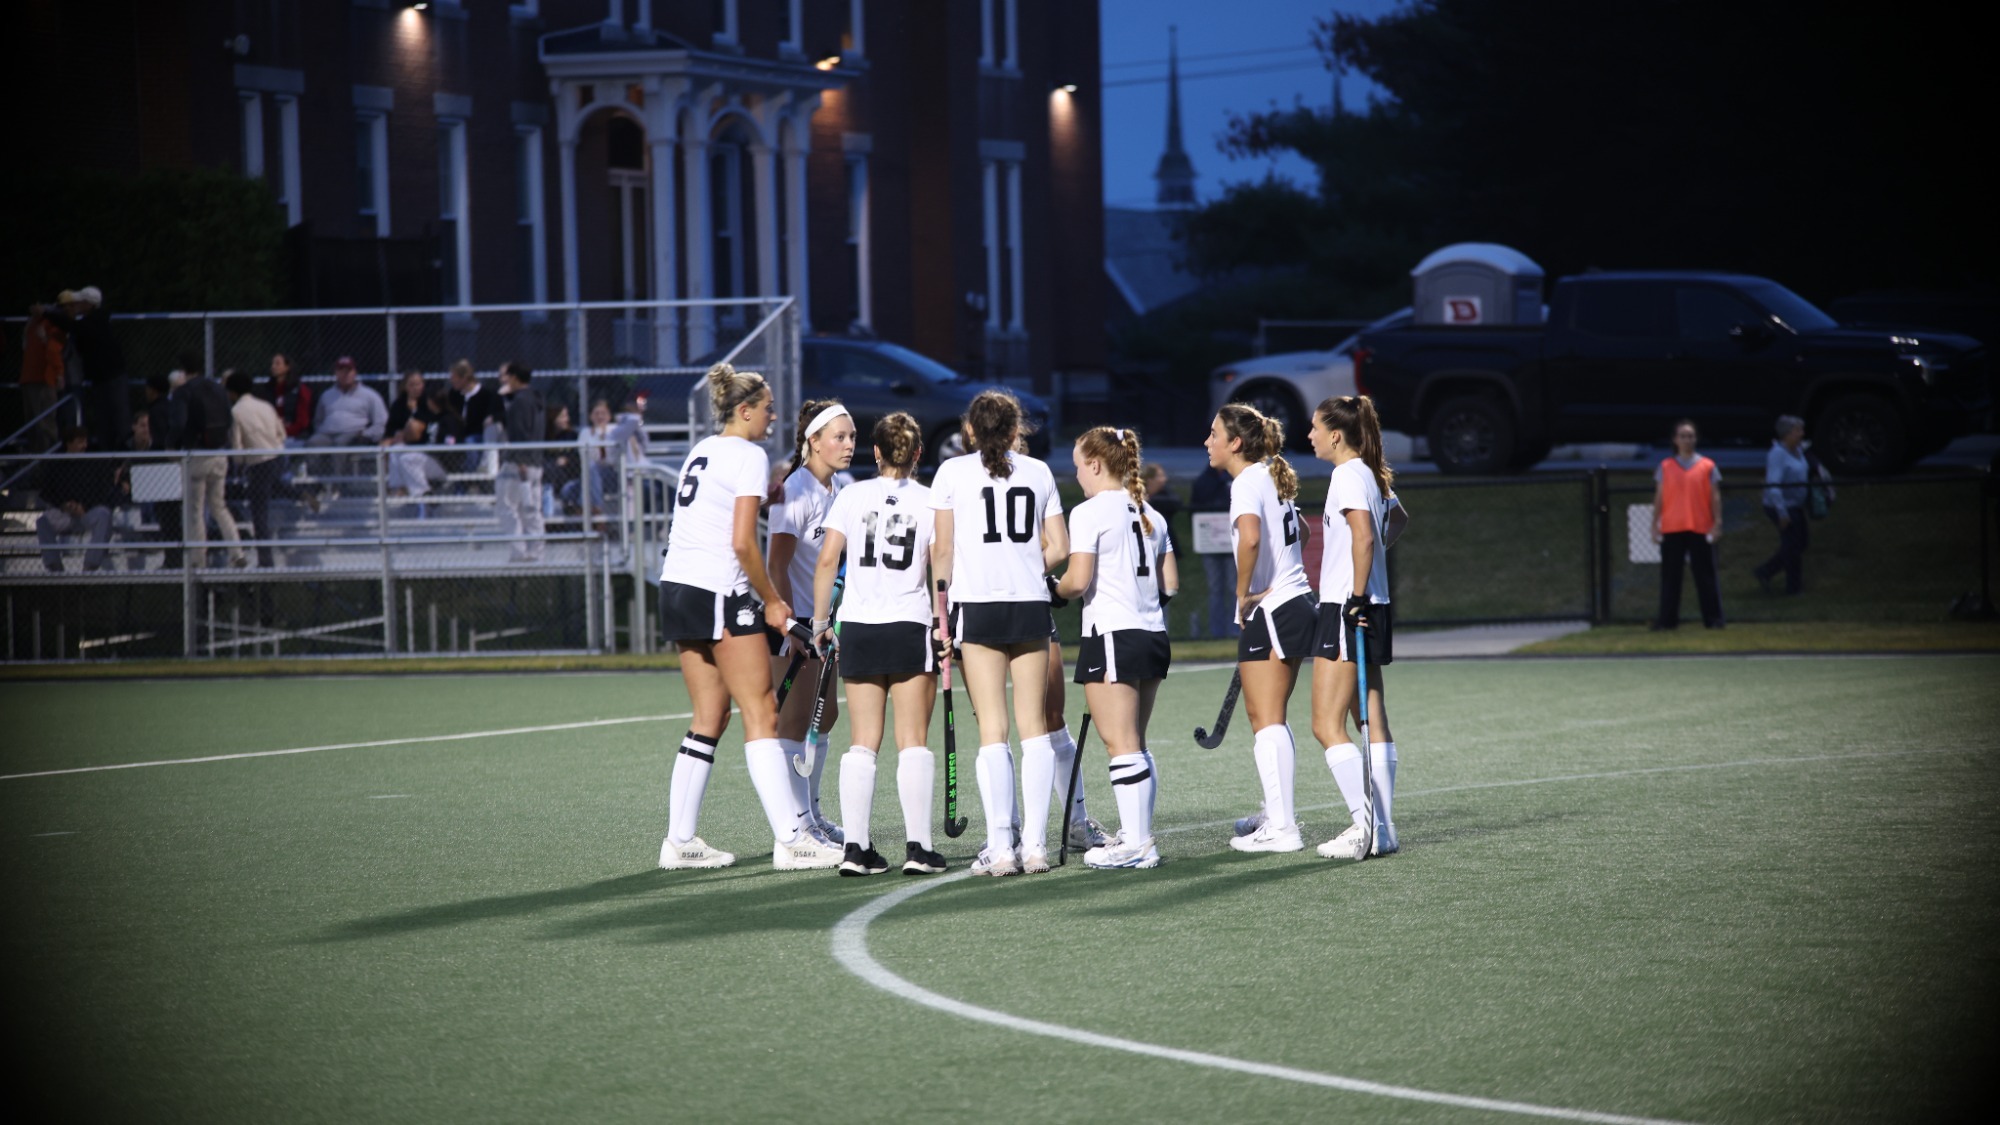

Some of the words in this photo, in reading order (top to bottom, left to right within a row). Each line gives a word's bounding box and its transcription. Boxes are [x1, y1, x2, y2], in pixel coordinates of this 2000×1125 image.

[678, 456, 708, 507] 6
[979, 486, 1035, 543] 10
[859, 511, 917, 571] 19
[1132, 521, 1149, 576] 1
[812, 697, 825, 732] ritual
[681, 851, 704, 859] OSAKA
[793, 850, 816, 858] OSAKA
